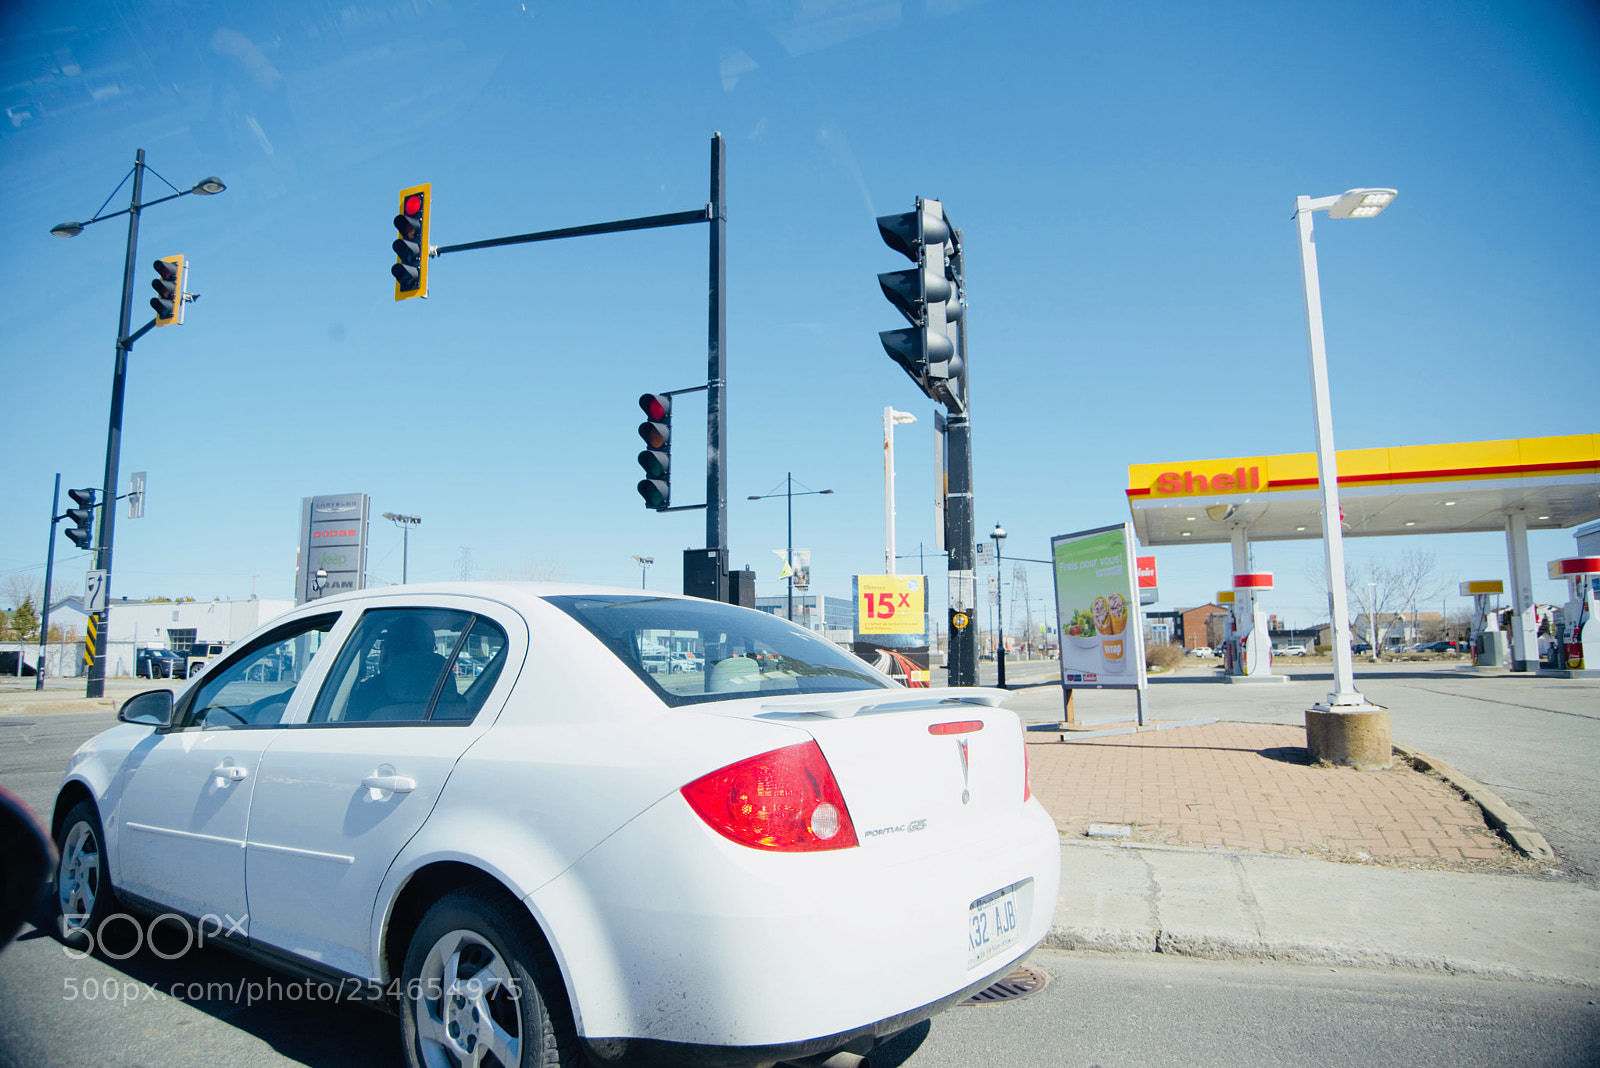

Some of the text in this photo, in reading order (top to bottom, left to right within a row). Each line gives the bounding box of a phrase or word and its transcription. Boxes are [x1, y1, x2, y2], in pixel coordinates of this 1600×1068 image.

[1158, 466, 1259, 493] Shell
[313, 529, 356, 538] DODGE
[318, 552, 346, 567] Jeep
[1058, 552, 1122, 573] Frais pour vous!
[1104, 644, 1122, 656] wrap
[865, 818, 928, 838] PONTIAC G5
[995, 900, 1016, 936] AJB
